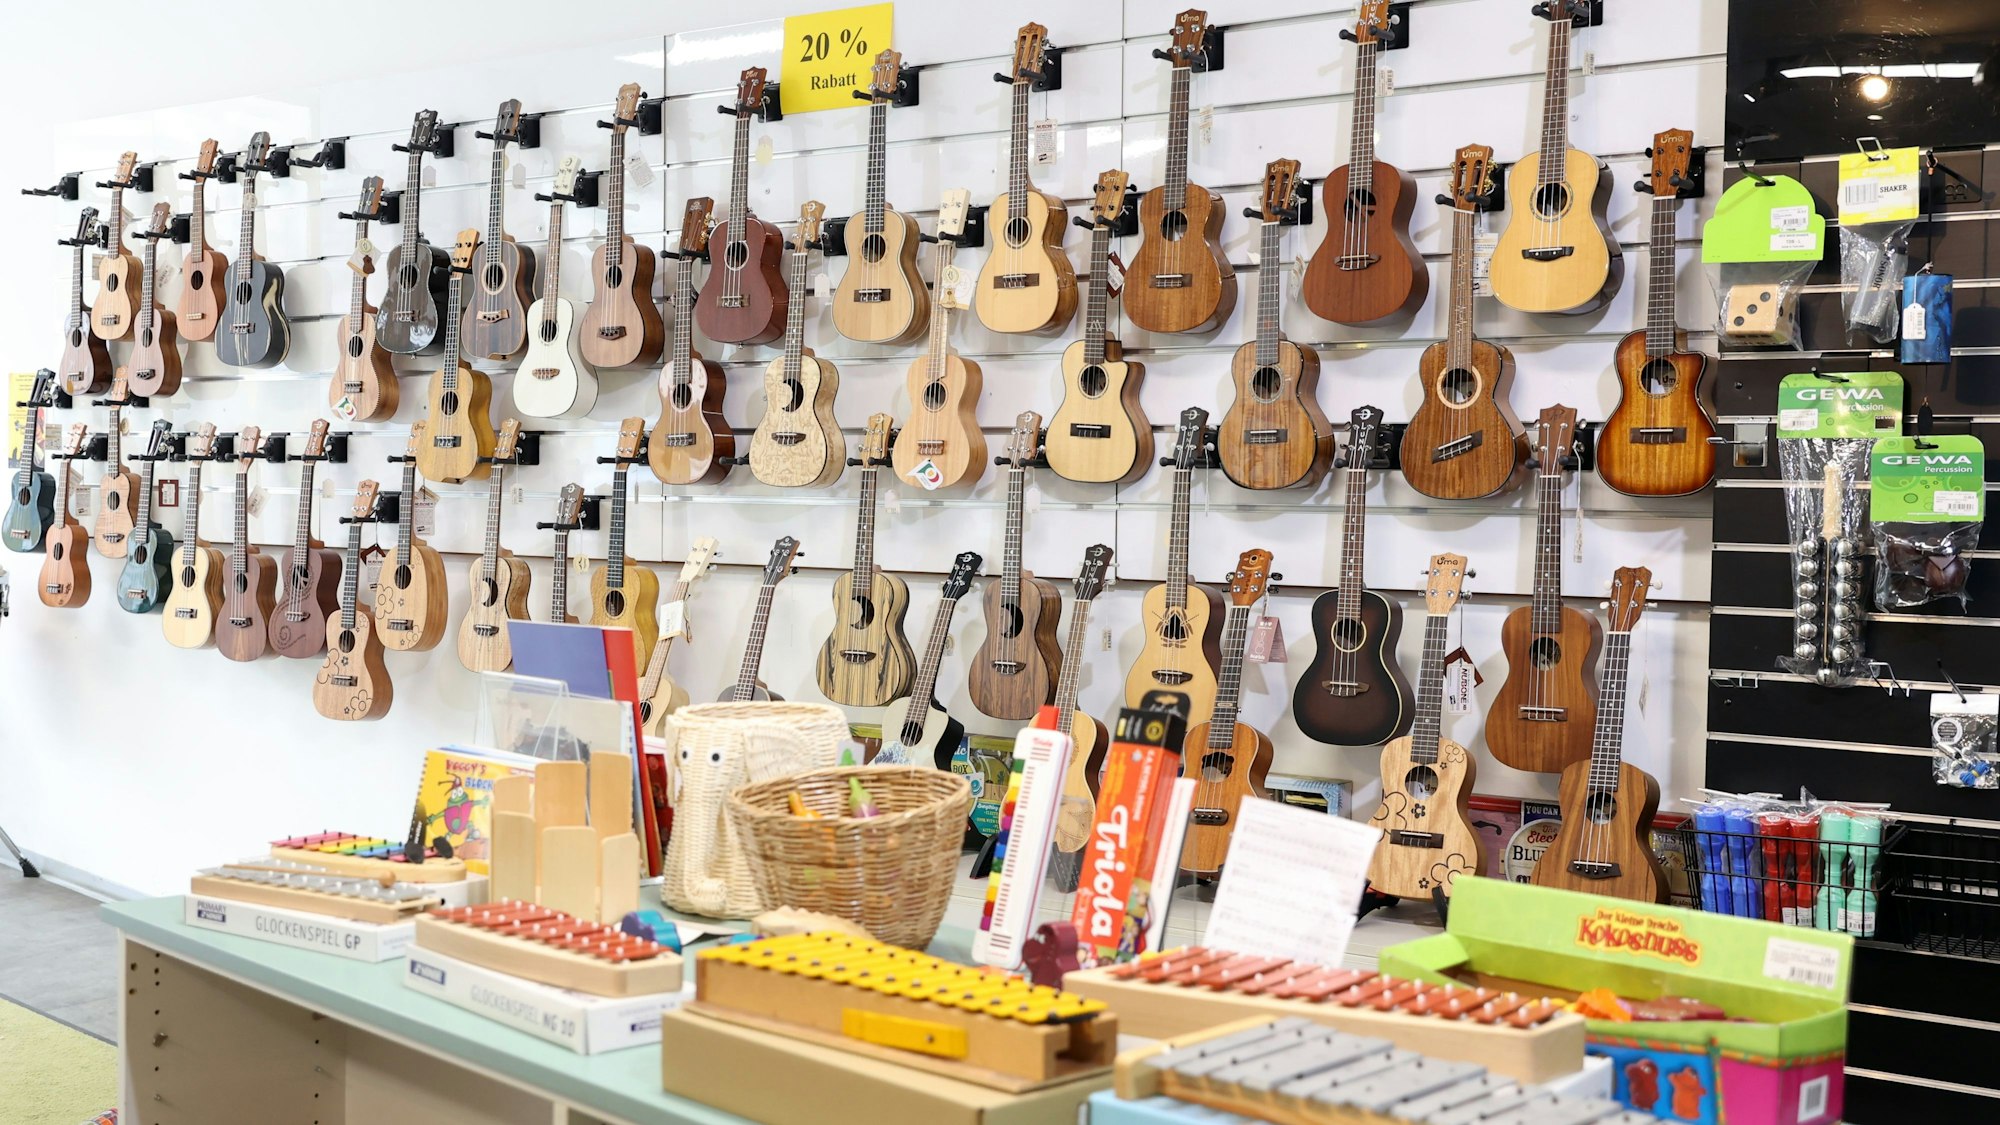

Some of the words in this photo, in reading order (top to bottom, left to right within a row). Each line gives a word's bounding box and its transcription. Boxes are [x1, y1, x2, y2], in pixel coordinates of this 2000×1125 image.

[800, 32, 830, 62] 20
[840, 26, 868, 58] %
[810, 72, 857, 90] Rabatt
[1879, 184, 1908, 193] SHAKER
[1796, 388, 1884, 401] GEWA
[1881, 455, 1972, 465] GEWA
[1525, 805, 1541, 815] YOU
[1542, 807, 1559, 816] CAN
[1090, 804, 1130, 939] Triola
[255, 914, 341, 948] GLOCKENSPIEL
[344, 933, 362, 951] GP
[1578, 917, 1699, 963] Kokosnuss
[469, 984, 540, 1026] GLOCKENSPIEL
[542, 1014, 559, 1031] NG
[560, 1018, 576, 1038] 10
